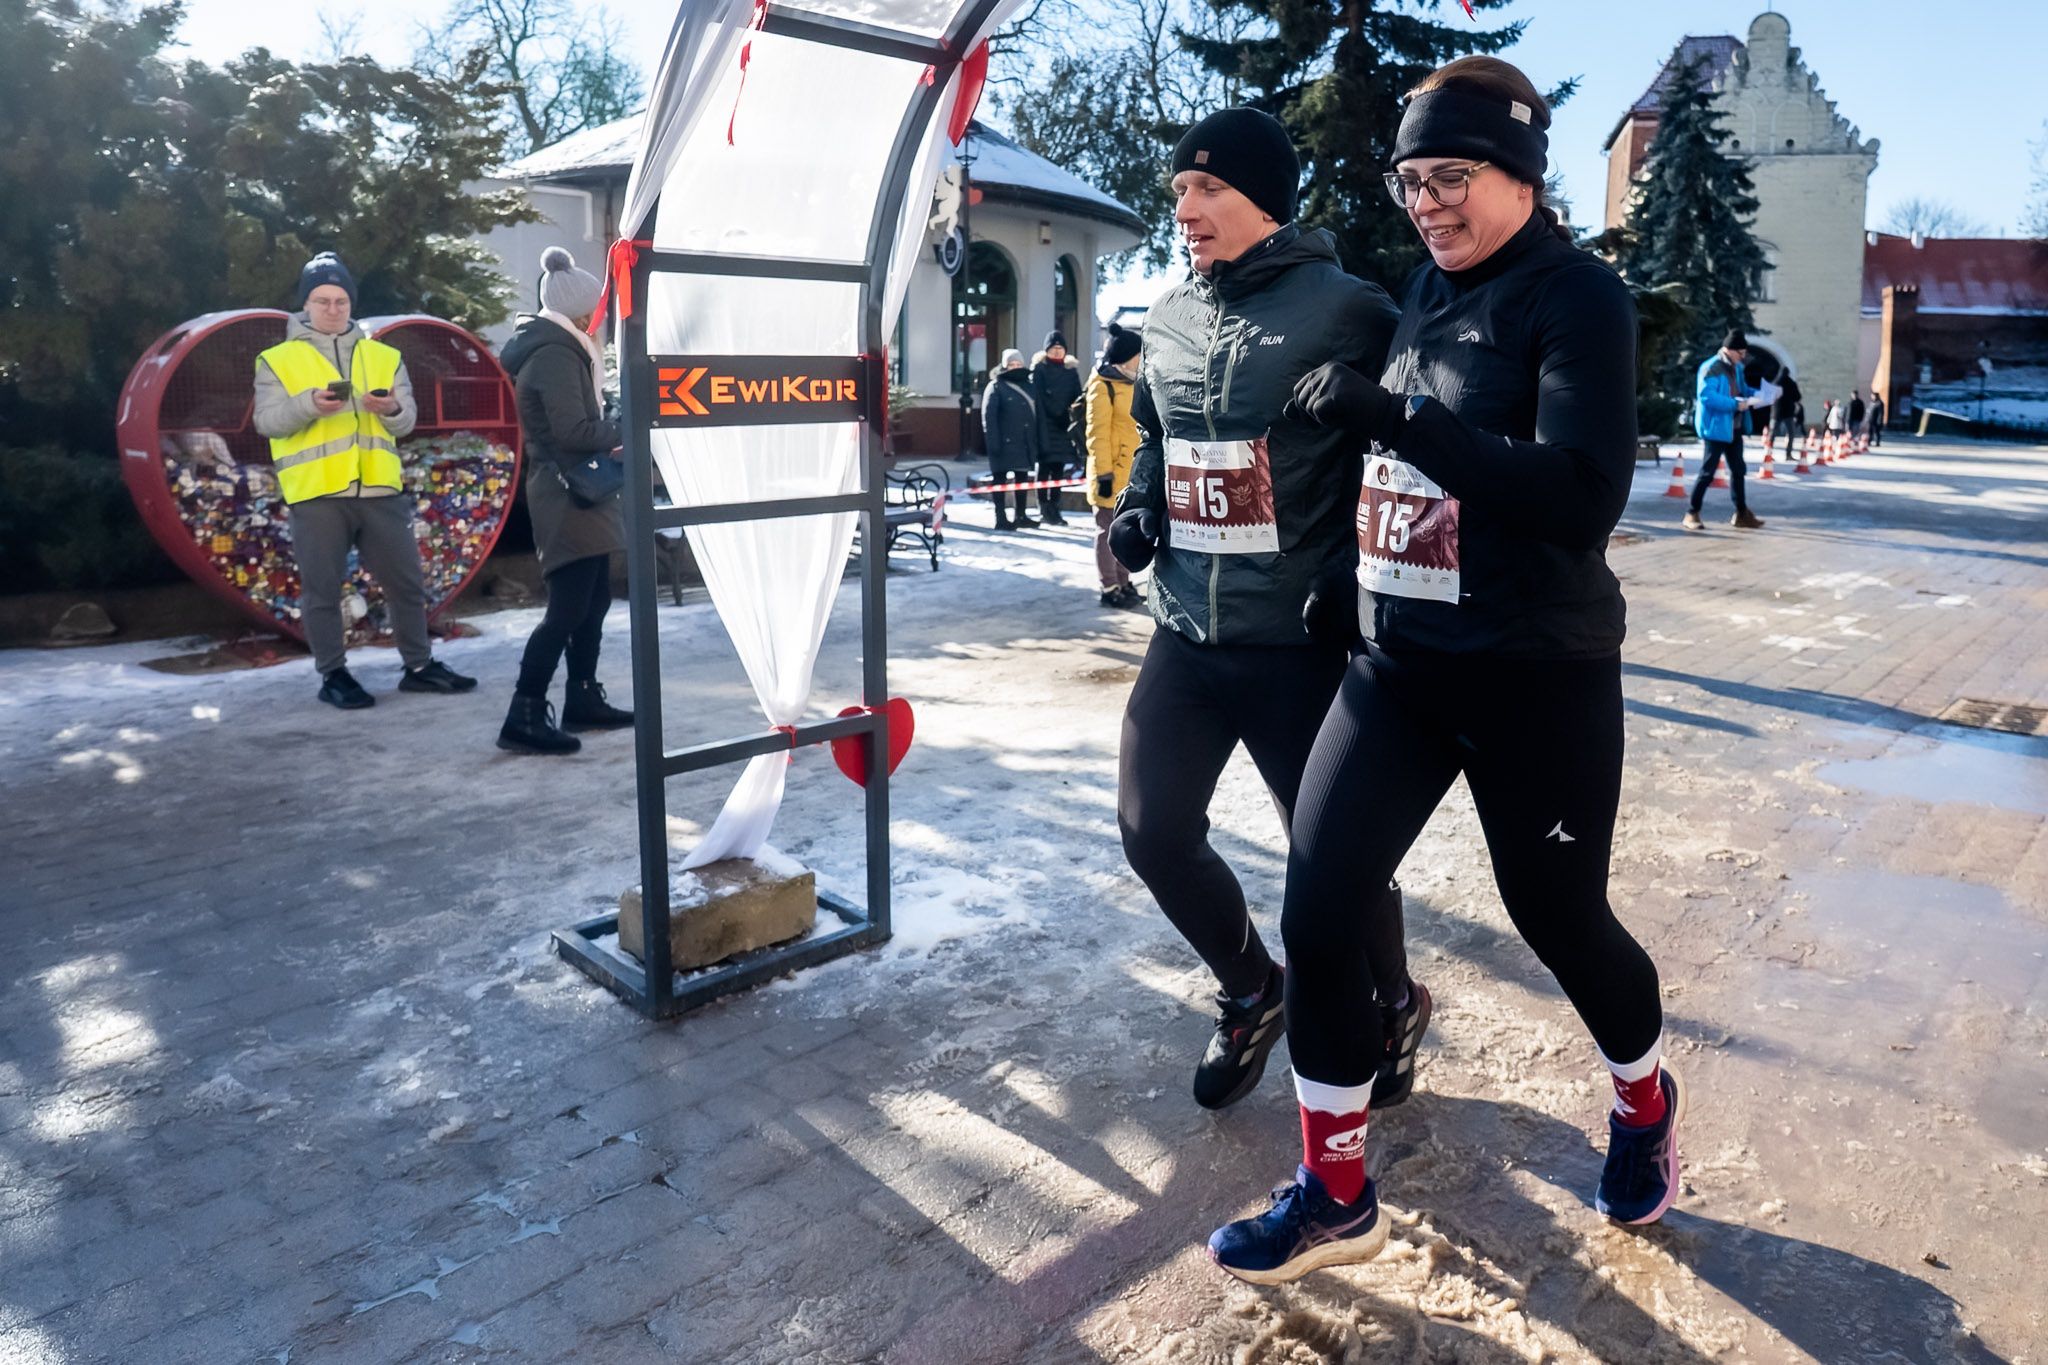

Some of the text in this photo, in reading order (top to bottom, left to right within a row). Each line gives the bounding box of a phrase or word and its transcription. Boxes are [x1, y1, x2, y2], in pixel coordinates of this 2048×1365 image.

[1259, 335, 1285, 346] RUN
[1195, 476, 1229, 519] 15
[1376, 500, 1414, 553] 15
